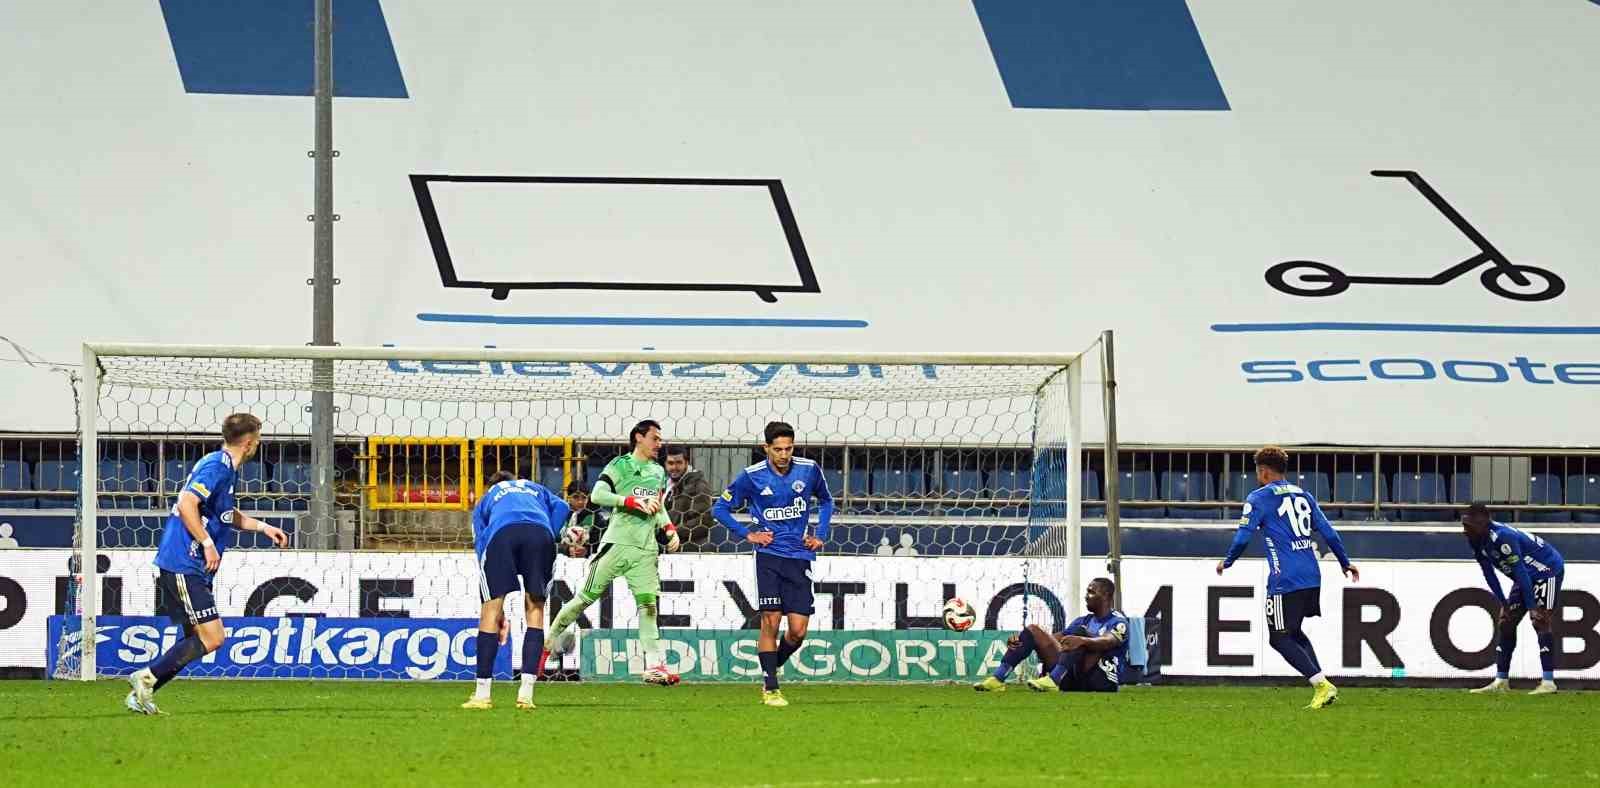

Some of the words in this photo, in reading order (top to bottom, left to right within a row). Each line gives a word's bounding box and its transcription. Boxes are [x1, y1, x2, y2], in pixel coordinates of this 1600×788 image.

[1241, 356, 1600, 385] scoote
[1277, 496, 1312, 537] 18
[1341, 586, 1600, 670] ROB
[730, 638, 1008, 676] SGORTA
